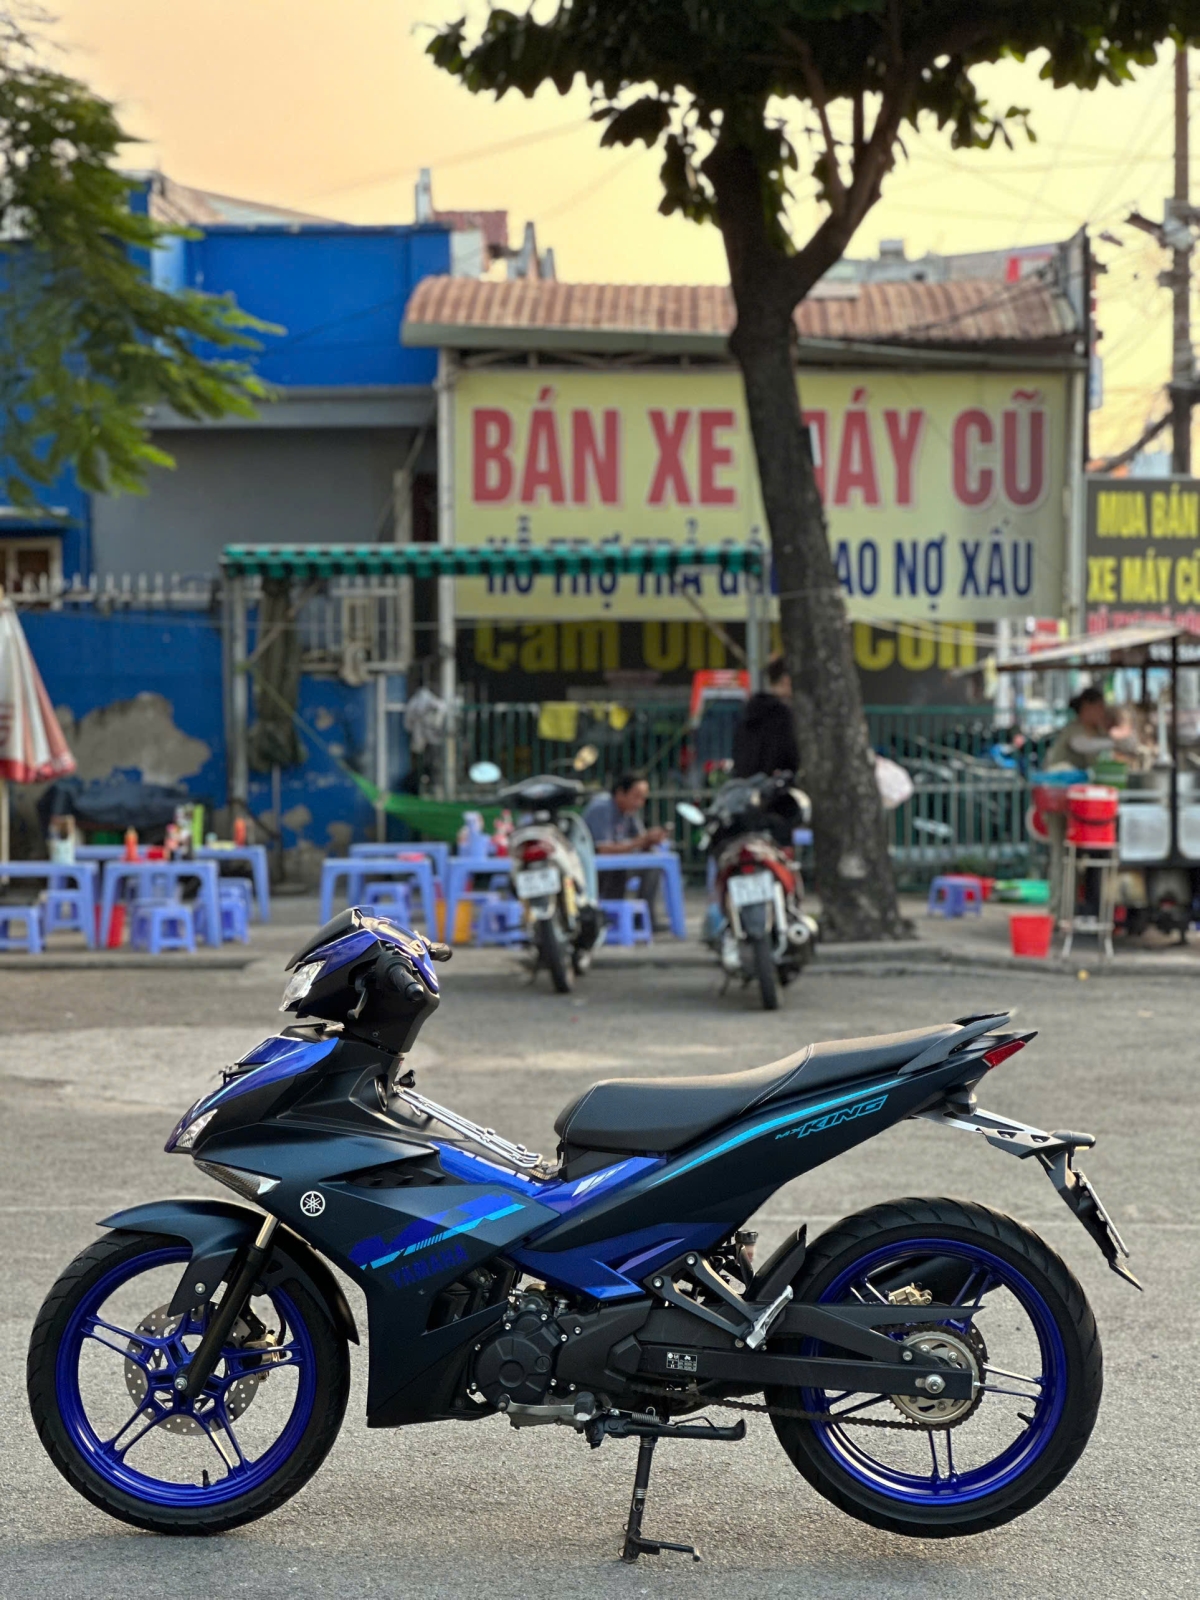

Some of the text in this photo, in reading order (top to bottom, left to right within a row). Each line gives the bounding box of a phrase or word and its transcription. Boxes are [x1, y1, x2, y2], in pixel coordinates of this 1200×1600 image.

[471, 386, 620, 505] BÁN
[646, 408, 737, 505] XE
[951, 388, 1045, 506] CŨ
[1097, 490, 1147, 538] MUA
[831, 540, 879, 597] AO
[894, 534, 946, 612] NỢ
[959, 519, 1034, 598] XẤU
[1087, 556, 1117, 603] XE
[797, 1094, 889, 1139] KING
[389, 1243, 469, 1290] YAMAHA
